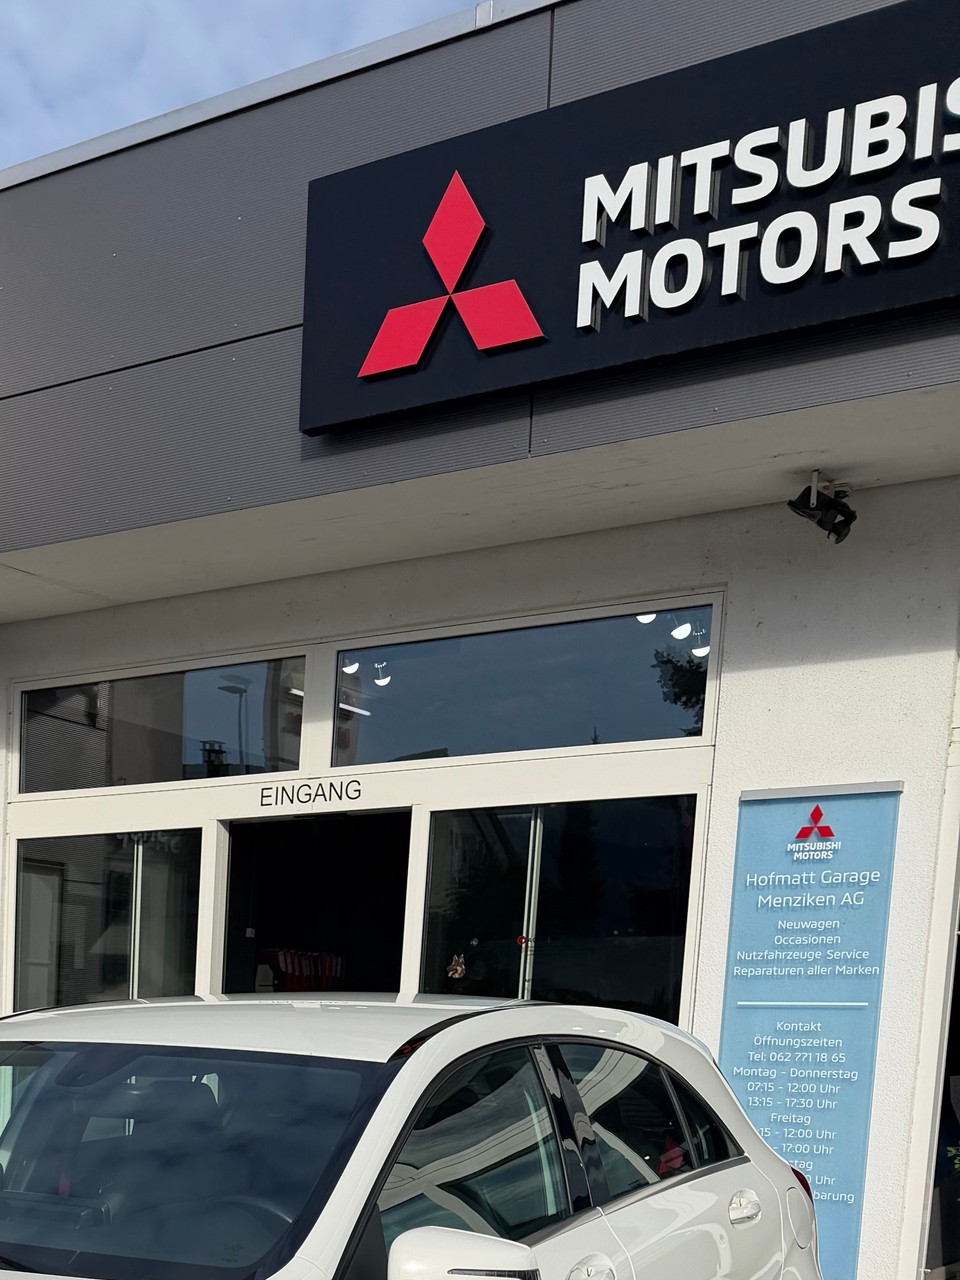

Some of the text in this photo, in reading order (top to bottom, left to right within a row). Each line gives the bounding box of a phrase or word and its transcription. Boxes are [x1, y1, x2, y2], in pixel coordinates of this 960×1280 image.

[576, 177, 942, 329] MOTORS
[260, 780, 361, 807] EINGANG
[787, 841, 841, 852] MITSUBISHI
[793, 850, 833, 861] MOTORS
[746, 870, 881, 887] Hofmatt Garage
[758, 891, 864, 908] Menziken AG
[777, 920, 840, 931] Neuwagen
[774, 935, 841, 945] Occasionen
[736, 949, 870, 962] Nutzfahrzeuge Service
[733, 965, 880, 978] Reparaturen aller Marken
[776, 1021, 822, 1031] Kontakt
[753, 1034, 843, 1048] Öffnungszeiten
[748, 1052, 846, 1063] Tel: 062 771 18 65
[733, 1067, 777, 1079] Montag
[790, 1068, 859, 1081] Donnerstag
[747, 1082, 774, 1092] 07:15
[788, 1083, 817, 1093] 12:00
[820, 1084, 841, 1094] Uhr
[748, 1097, 773, 1107] 13:15
[786, 1098, 813, 1108] 17:30
[816, 1099, 838, 1109] Uhr
[770, 1112, 811, 1125] Freitag
[783, 1128, 813, 1138] 12:00
[816, 1129, 837, 1139] Uhr
[782, 1143, 810, 1154] 17:00
[813, 1144, 834, 1154] Uhr
[815, 1175, 836, 1185] Uhr
